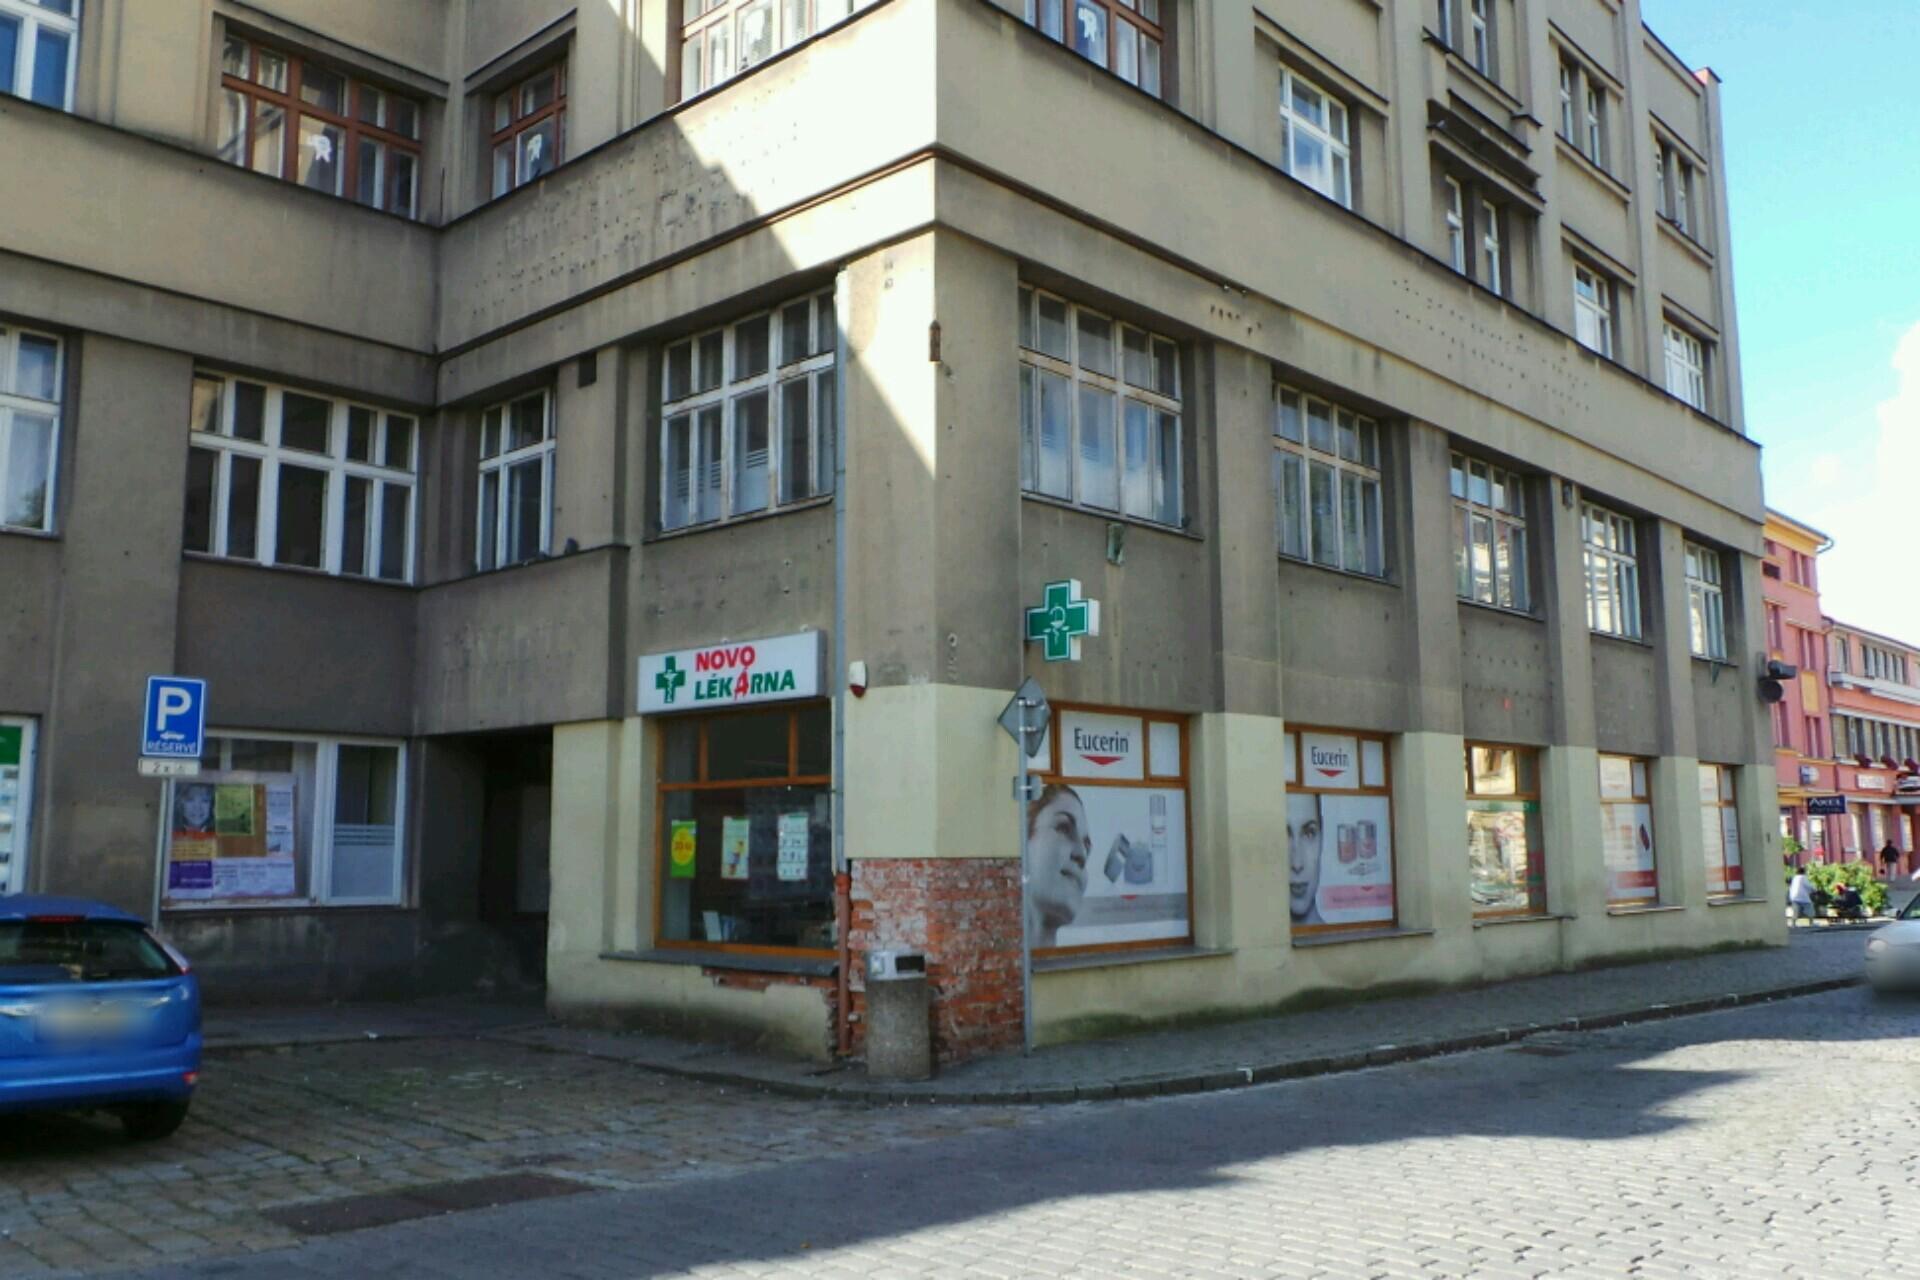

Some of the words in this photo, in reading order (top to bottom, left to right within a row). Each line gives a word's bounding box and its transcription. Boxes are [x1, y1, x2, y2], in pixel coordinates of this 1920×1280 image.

[695, 646, 756, 671] NOVO
[695, 668, 795, 700] LÉKÁRNA
[156, 686, 193, 731] P
[1074, 727, 1129, 753] Eucerin
[1311, 745, 1350, 767] Eucerin
